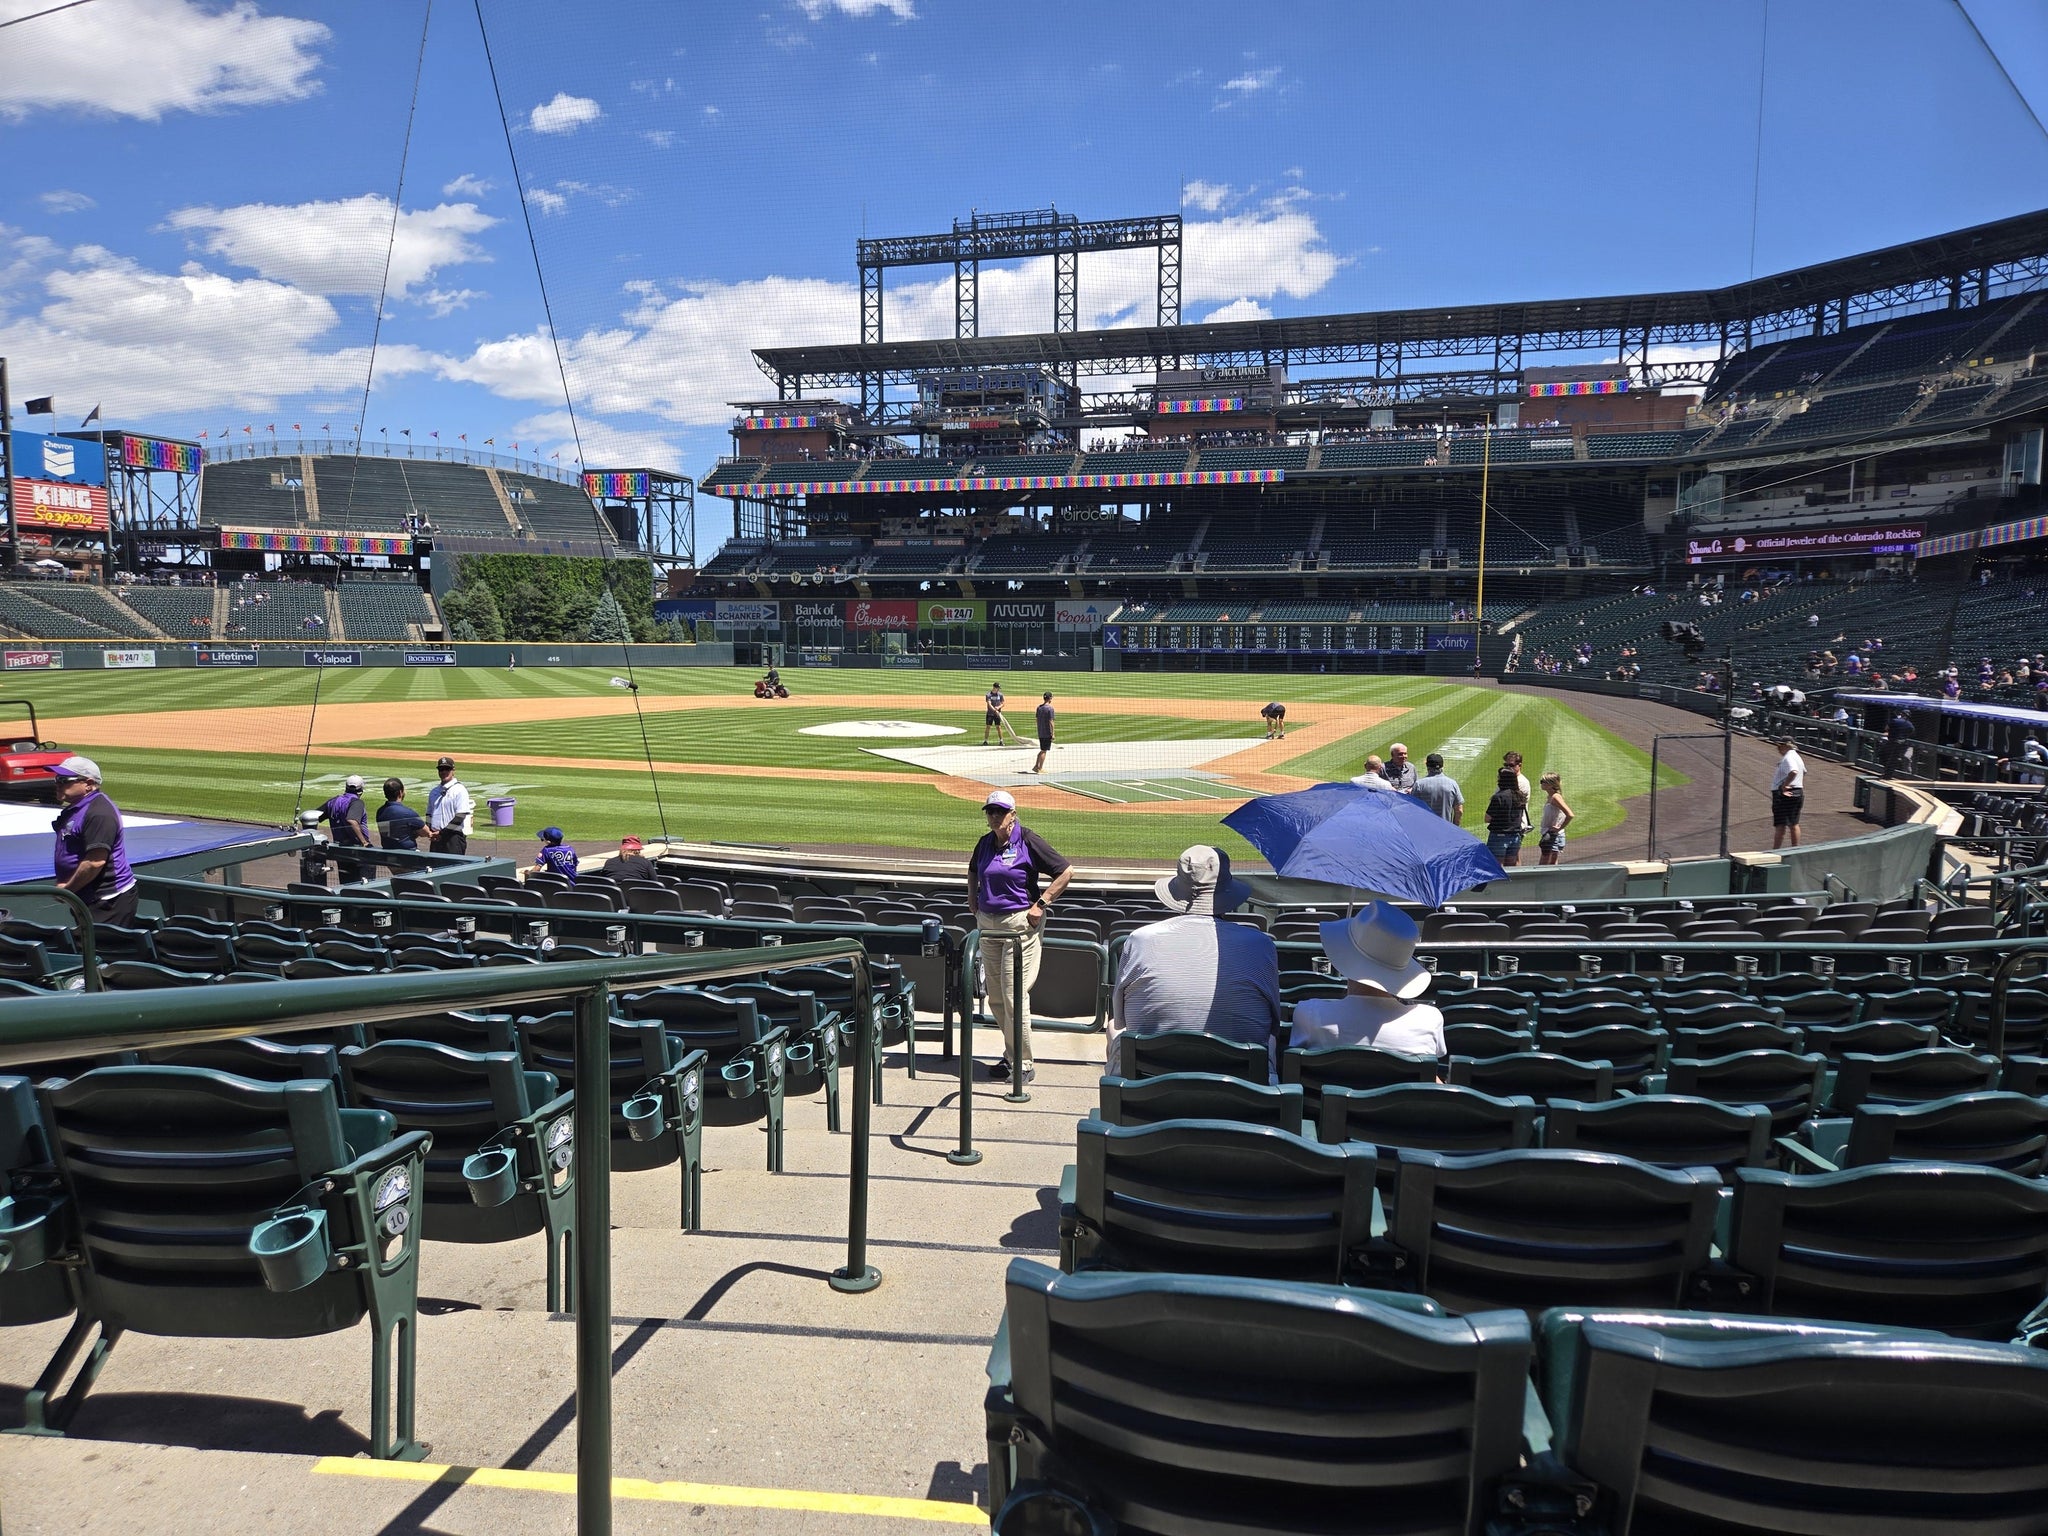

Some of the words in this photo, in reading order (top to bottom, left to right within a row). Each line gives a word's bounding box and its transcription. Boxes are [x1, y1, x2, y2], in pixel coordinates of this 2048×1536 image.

[43, 440, 74, 451] Chevron
[32, 484, 92, 510] KING
[1756, 538, 1785, 548] Official
[1786, 535, 1816, 548] Jeweler
[1817, 534, 1828, 545] of
[1829, 533, 1843, 544] the
[1844, 531, 1884, 542] Colorado
[1885, 529, 1921, 540] Rockies
[139, 545, 165, 553] PLATTE
[654, 608, 707, 620] Southwest
[728, 604, 762, 613] BACHUS
[795, 603, 821, 616] Bank
[823, 603, 835, 616] of
[954, 608, 973, 619] 24/7
[993, 604, 1046, 617] ARROW
[718, 612, 762, 621] SCHANKER
[795, 614, 844, 628] Colorado
[1057, 609, 1093, 625] Coors
[1435, 636, 1469, 649] xfinity
[212, 652, 254, 661] Lifetime
[318, 654, 352, 665] dialpad
[804, 654, 833, 662] bet365
[554, 850, 574, 866] 24
[561, 1151, 567, 1162] 9
[390, 1211, 405, 1230] 10
